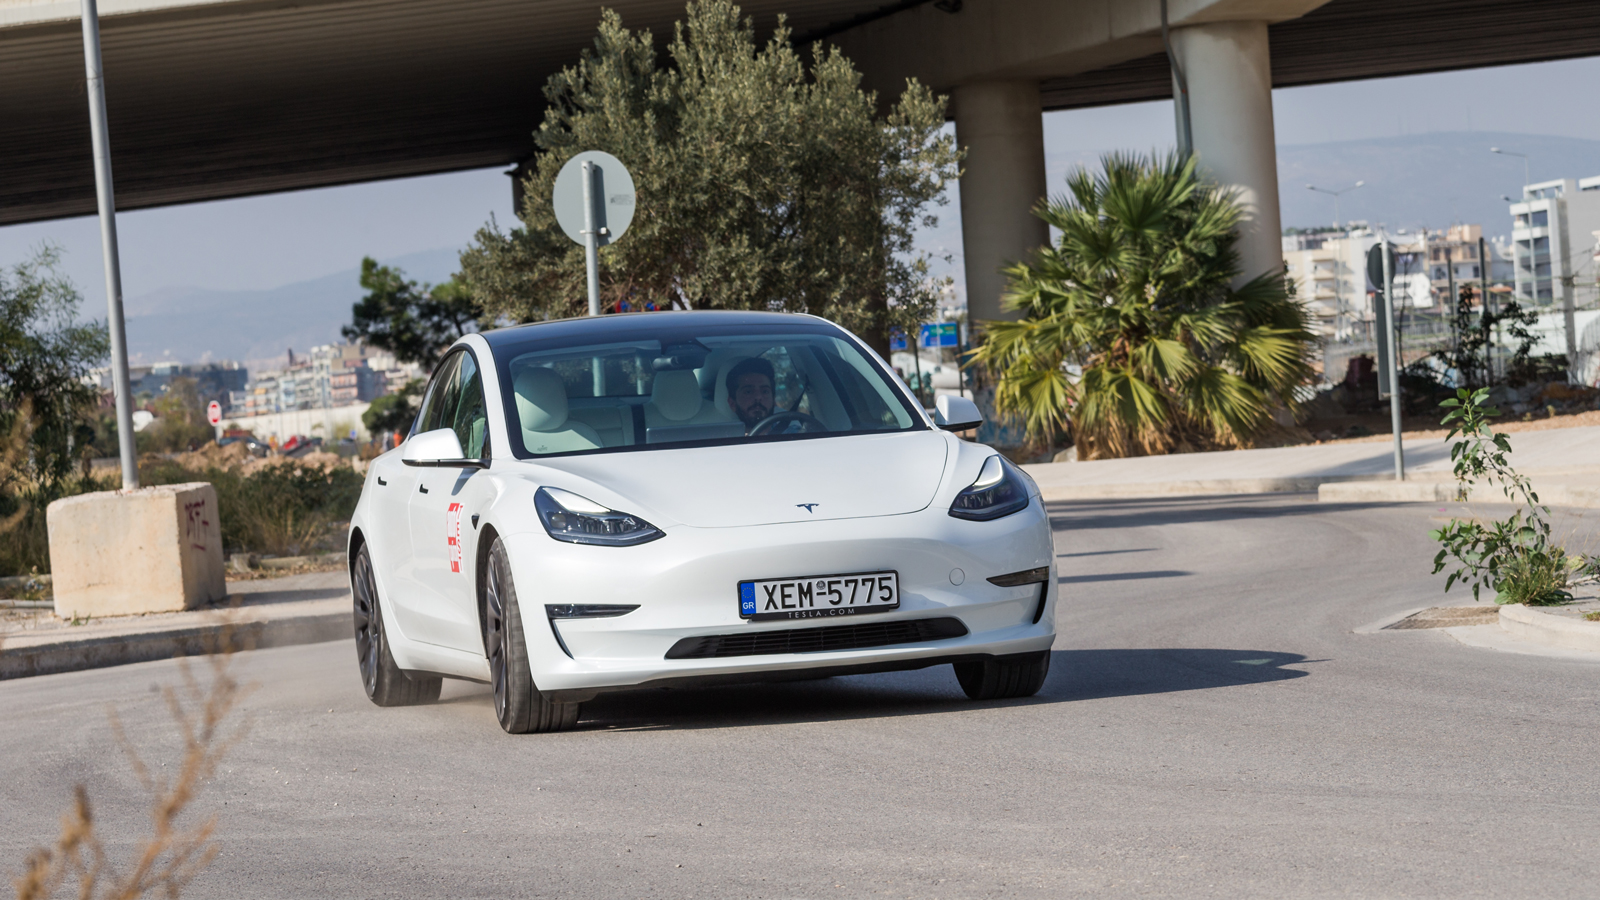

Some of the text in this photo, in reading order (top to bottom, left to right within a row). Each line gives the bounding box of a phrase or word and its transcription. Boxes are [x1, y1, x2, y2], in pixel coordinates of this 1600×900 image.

[763, 576, 893, 611] XEM-5775
[742, 602, 755, 610] GR
[788, 608, 855, 619] TESLA.COM
